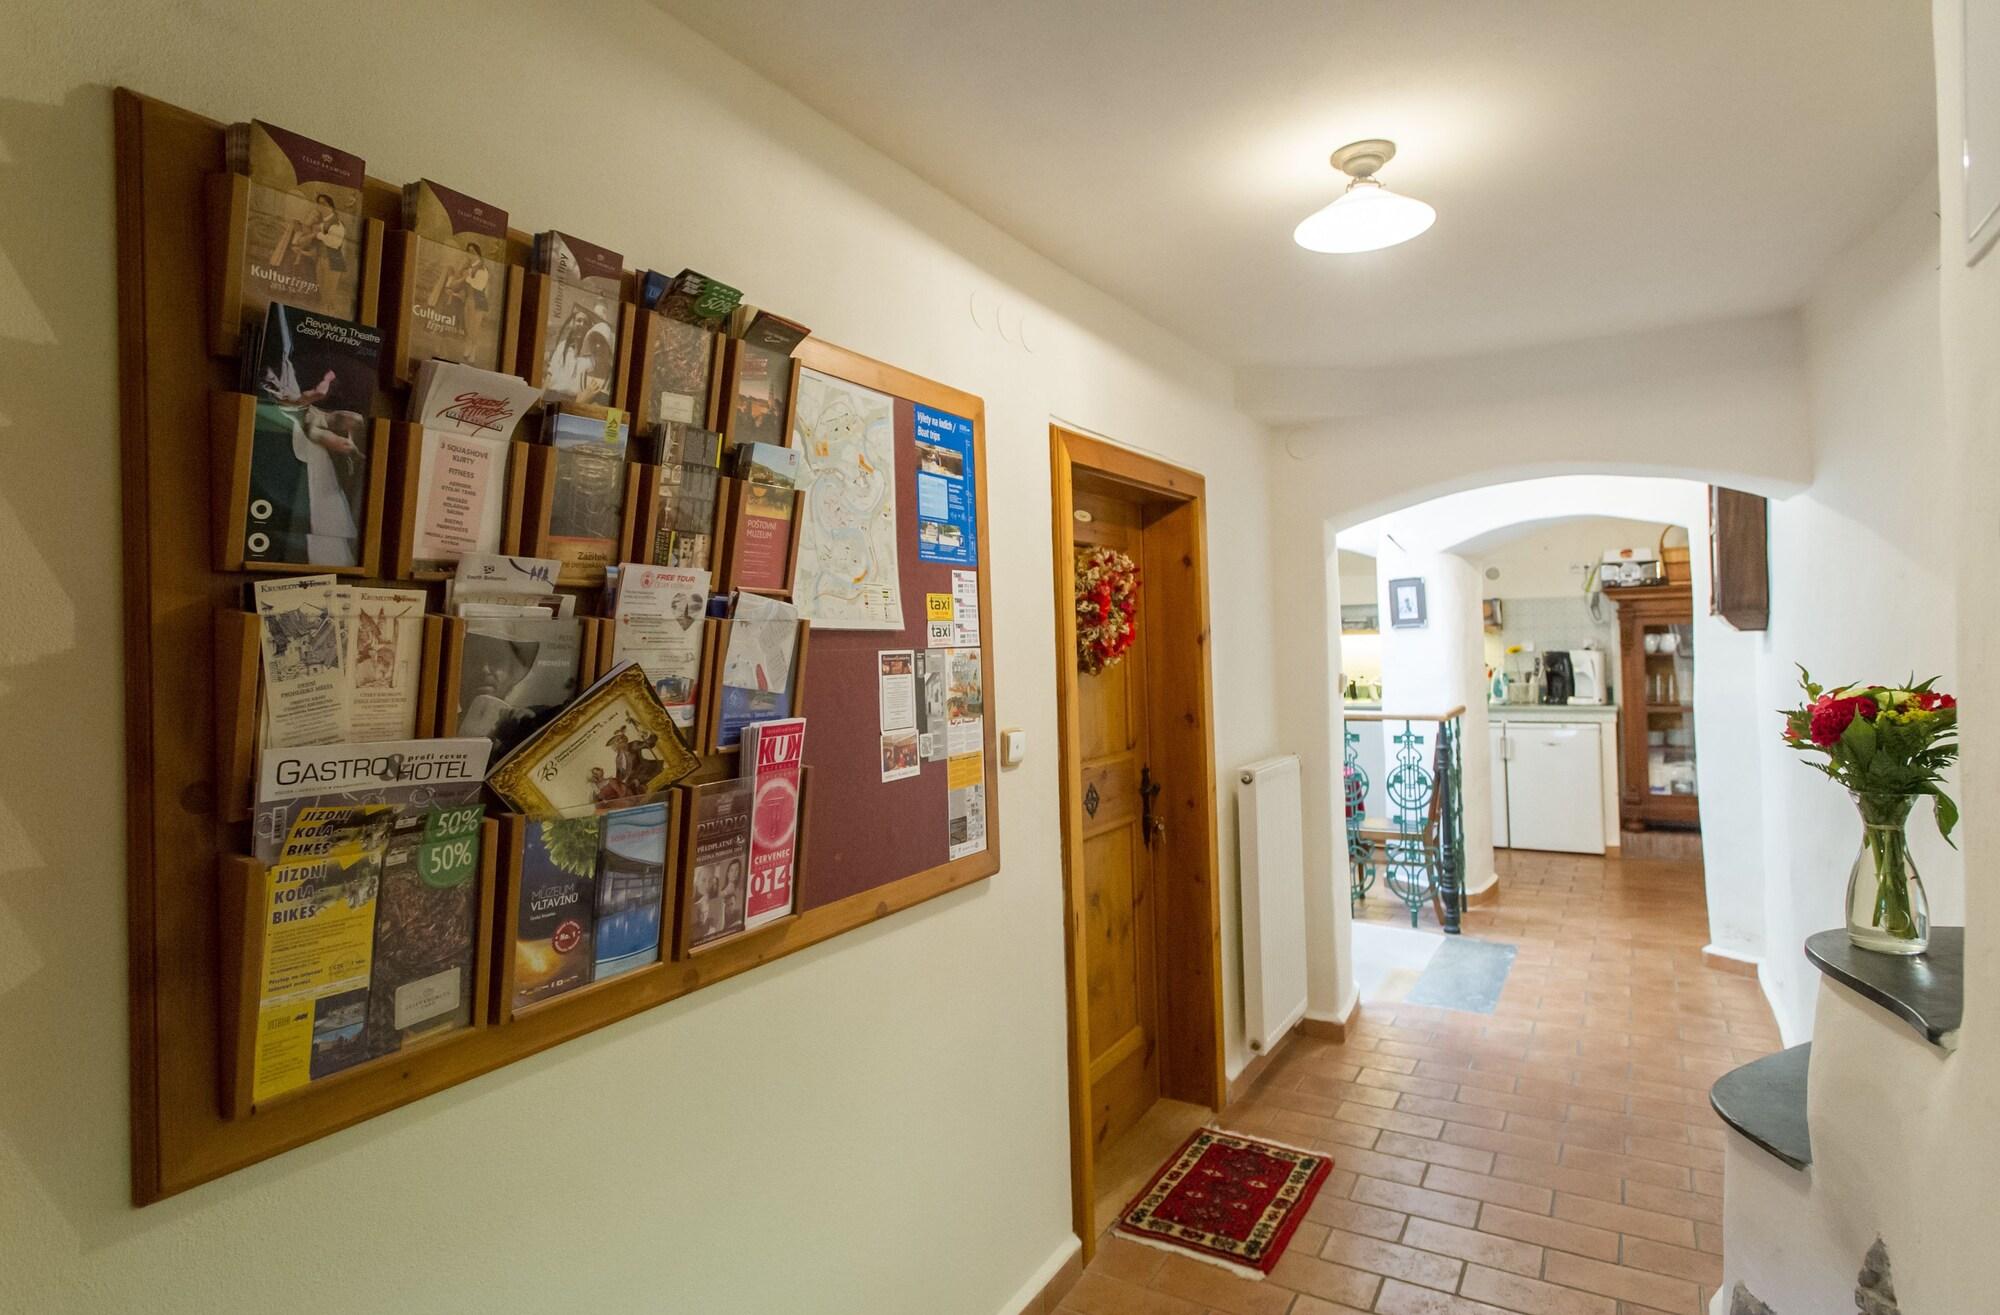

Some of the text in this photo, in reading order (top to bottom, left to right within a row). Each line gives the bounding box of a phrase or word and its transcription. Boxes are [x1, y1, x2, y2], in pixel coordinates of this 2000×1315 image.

[412, 304, 456, 326] Cultural
[305, 317, 380, 344] Revolving Theatre
[326, 331, 361, 347] Krumlov
[448, 467, 475, 479] FITNESS
[747, 529, 772, 538] MUZEUM
[656, 573, 696, 583] FREE TOUR
[929, 596, 950, 611] taxi
[931, 624, 951, 638] taxi
[407, 753, 435, 763] profi
[436, 807, 481, 837] 50%
[294, 824, 334, 839] KOLA
[287, 842, 331, 857] BIKES
[430, 840, 472, 878] 50%
[274, 883, 316, 905] KOLA
[531, 883, 575, 900] MUZEUM
[272, 905, 316, 925] BIKES
